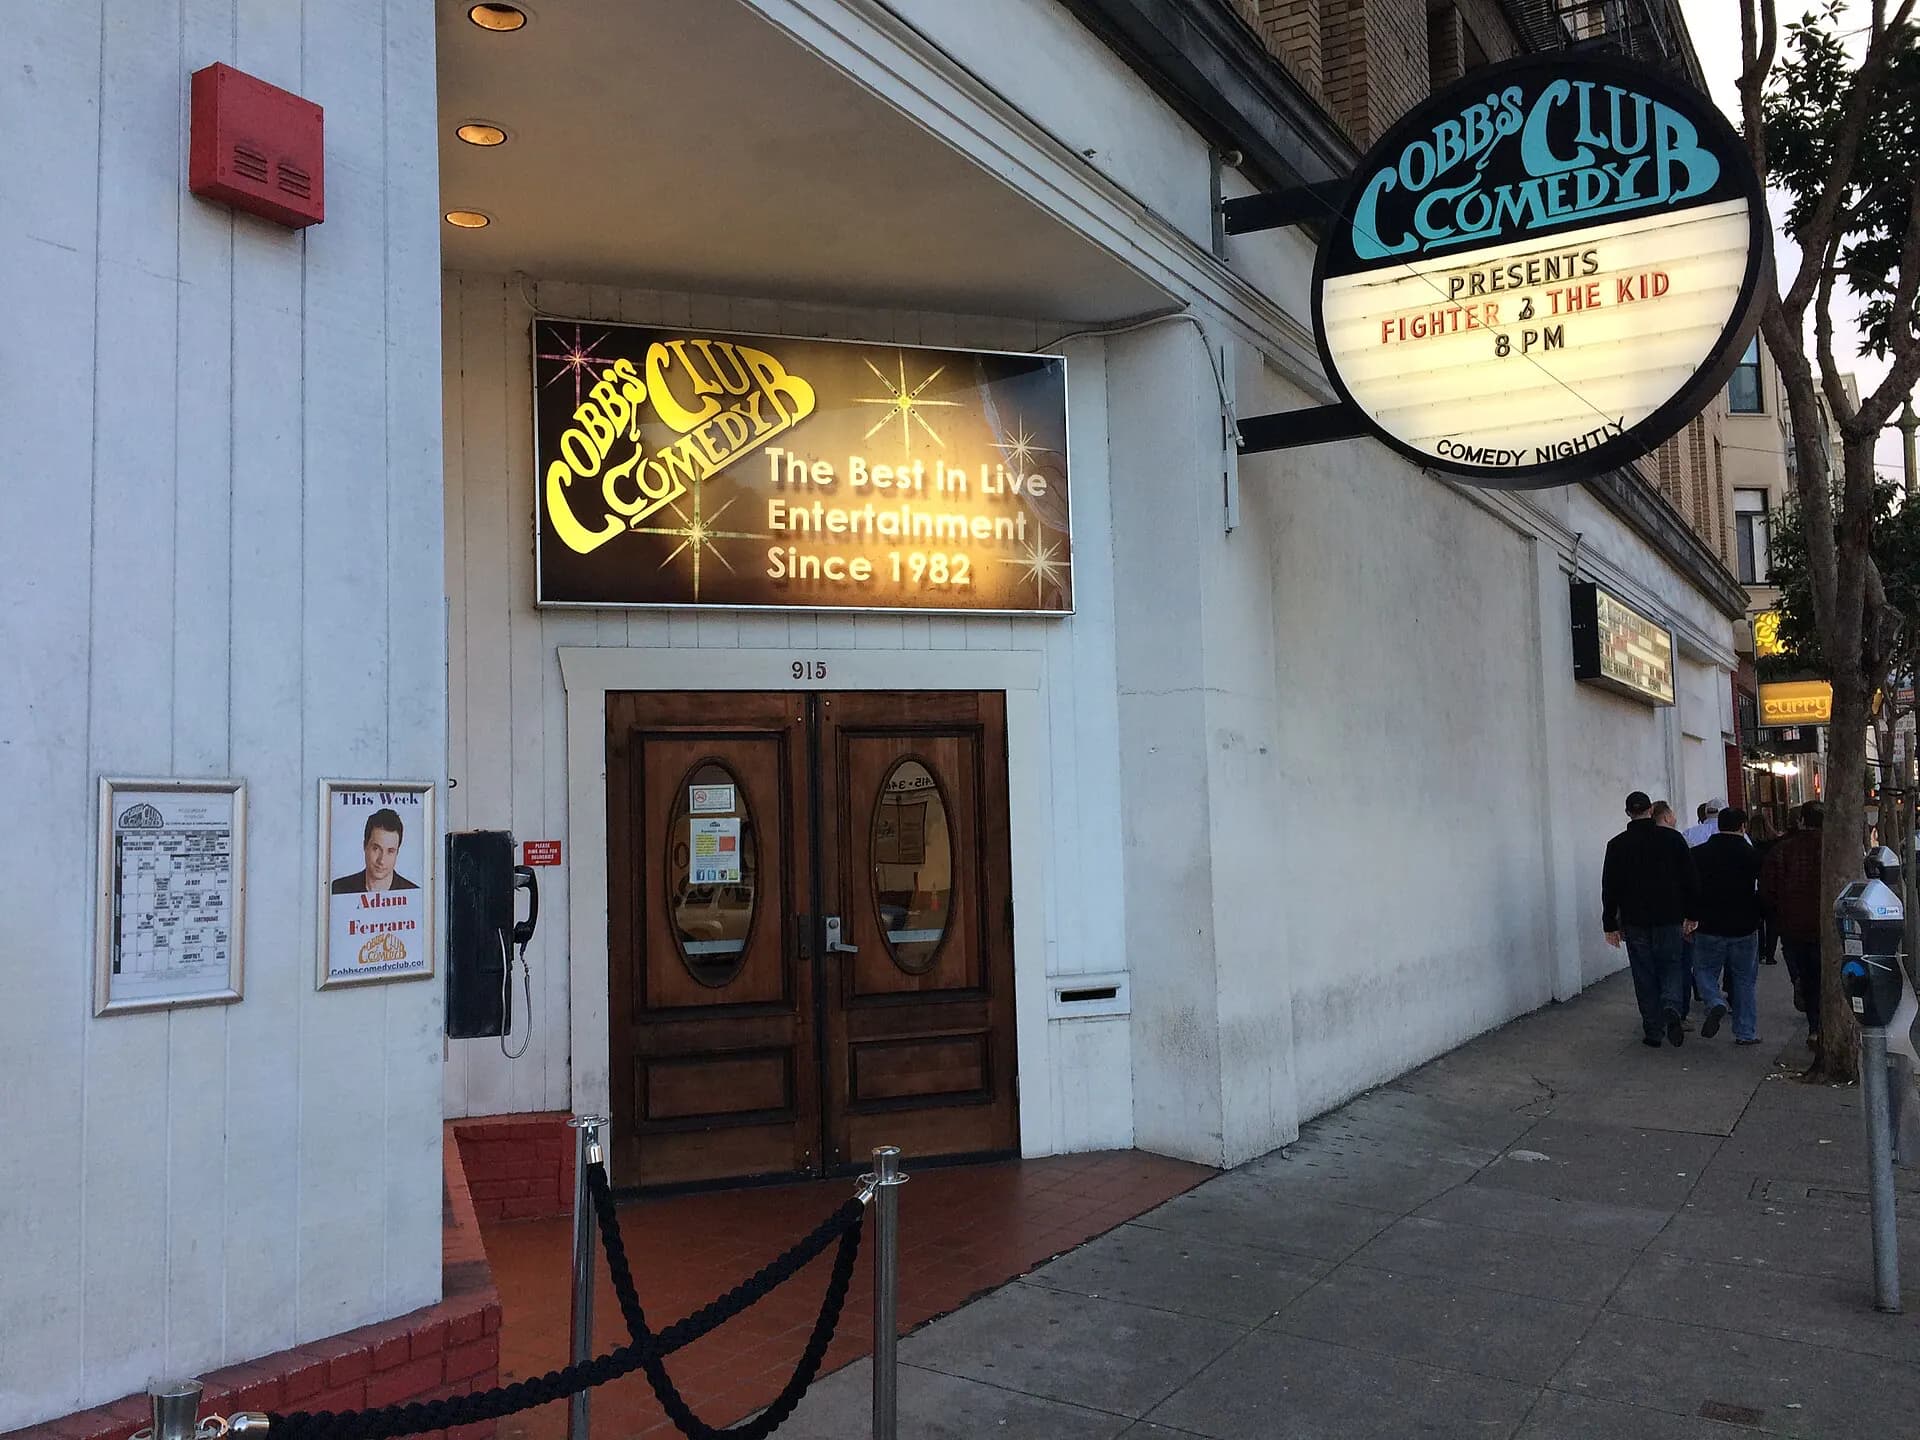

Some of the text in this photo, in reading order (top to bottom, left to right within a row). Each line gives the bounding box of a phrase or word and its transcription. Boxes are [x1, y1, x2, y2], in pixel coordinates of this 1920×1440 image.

[1352, 78, 1721, 260] COBB'S CLUB
[1413, 154, 1651, 252] COMEDY
[1448, 248, 1600, 300] PRESENTS
[1381, 302, 1501, 344] FIGHTER
[1546, 279, 1601, 315] THE
[1616, 271, 1670, 303] KID
[1494, 324, 1566, 358] 8 PM
[546, 339, 816, 554] COBB'S CLUB
[601, 395, 772, 518] COMEDY
[1436, 416, 1626, 467] COMEDY NIGHTLY
[764, 447, 833, 486] The
[848, 455, 925, 491] Best
[981, 463, 1048, 497] Live
[767, 499, 1027, 541] Entertainment
[766, 547, 971, 585] Since 1982
[791, 661, 827, 680] 915
[1765, 696, 1829, 718] curry
[339, 792, 419, 806] This Week
[356, 893, 408, 909] Adam
[349, 919, 416, 935] Ferrara
